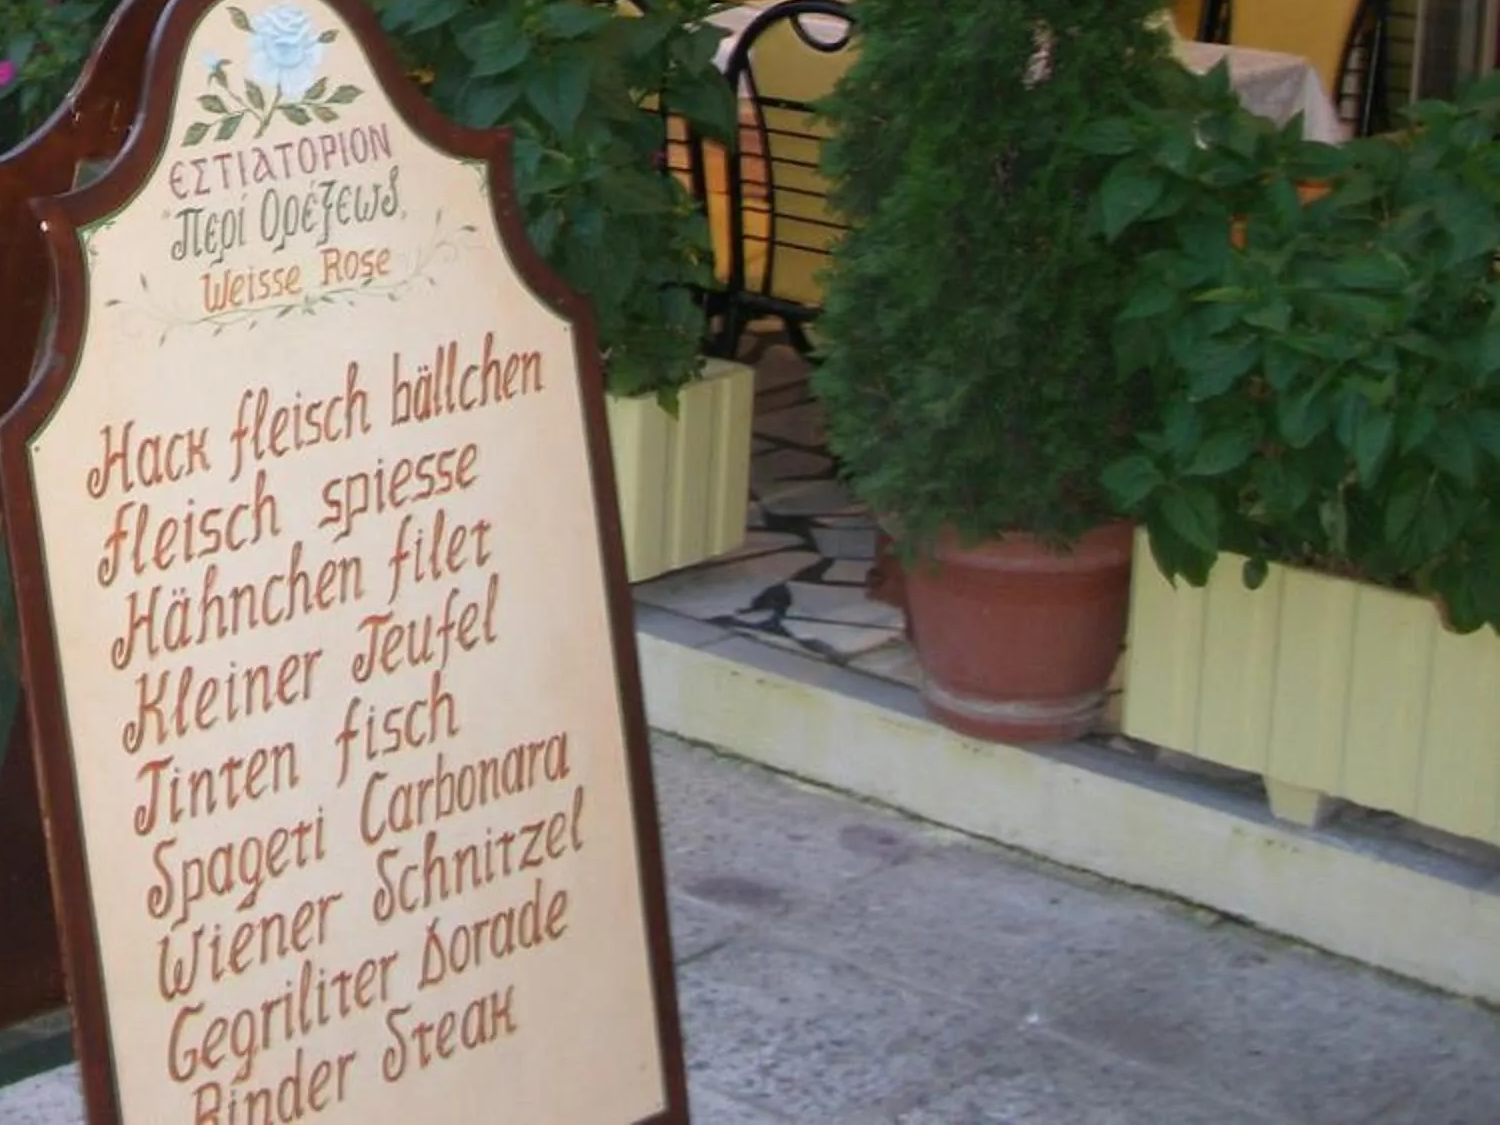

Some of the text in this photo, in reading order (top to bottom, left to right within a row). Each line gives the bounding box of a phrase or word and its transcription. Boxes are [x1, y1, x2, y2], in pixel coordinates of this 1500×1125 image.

[200, 247, 392, 314] Weisse Rose
[87, 331, 546, 500] Hack fleisch bällchen
[318, 441, 480, 543] spiesse
[111, 508, 494, 671] Hähnchen filet
[122, 572, 501, 755] Kleiner Teufel
[133, 670, 460, 837] Tinten fisch
[146, 731, 571, 929] Spageti Carbonara
[158, 786, 586, 1003] Wiener Schnitzel
[418, 878, 570, 989] Dorade
[192, 984, 518, 1125] Rinder Steak
